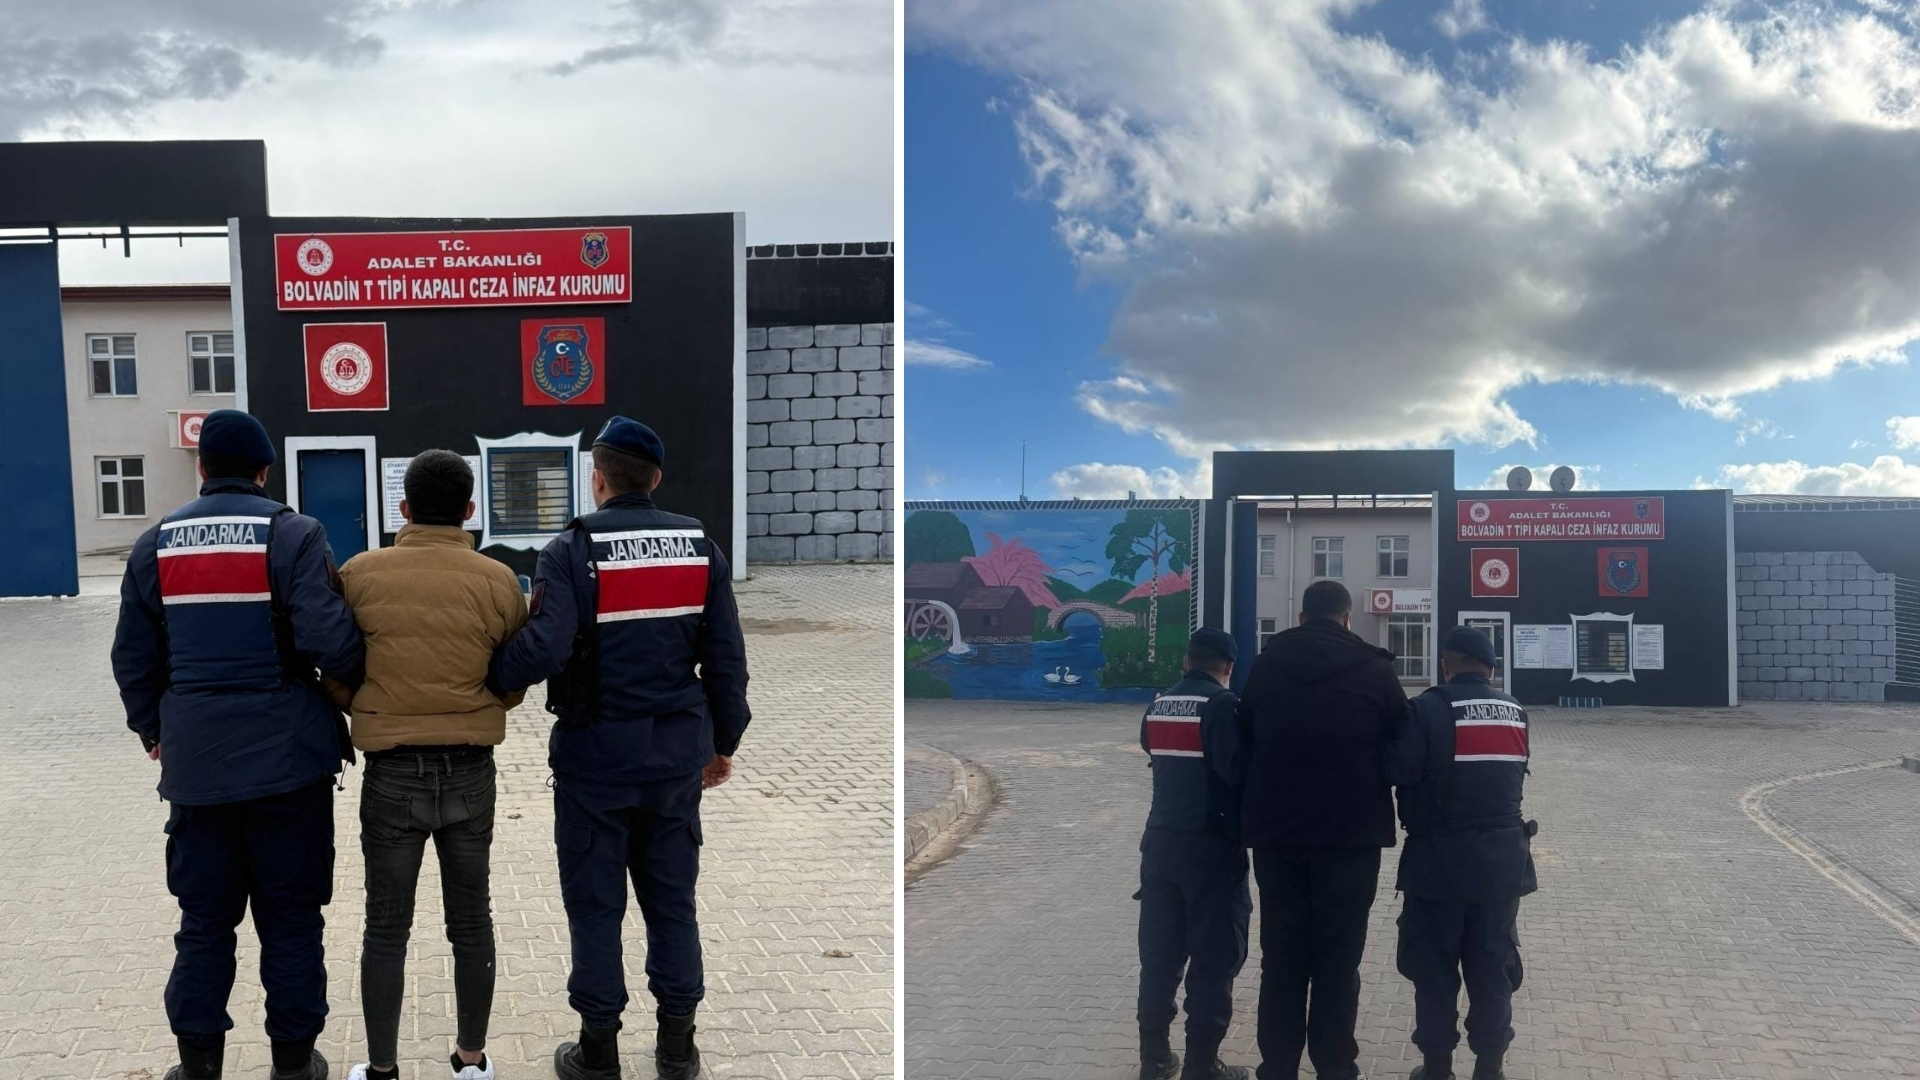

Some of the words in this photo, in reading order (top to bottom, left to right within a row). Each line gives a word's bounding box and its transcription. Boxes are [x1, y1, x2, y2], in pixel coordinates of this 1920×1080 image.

[438, 239, 470, 251] T.C.
[367, 257, 437, 269] ADALET
[443, 252, 542, 268] BAKANLIĞI
[284, 275, 360, 302] BOLVADİN
[363, 280, 373, 300] T
[377, 274, 407, 300] TİPİ
[412, 278, 465, 300] KAPALI
[469, 276, 509, 298] CEZA
[513, 271, 556, 298] İNFAZ
[560, 274, 625, 296] KURUMU
[1552, 510, 1611, 518] BAKANLIĞI
[166, 523, 256, 548] JANDARMA
[1461, 522, 1504, 537] BOLVADİN
[1507, 525, 1513, 536] T
[1514, 522, 1531, 536] TİPİ
[1534, 524, 1565, 536] KAPALI
[1567, 524, 1590, 536] CEZA
[1593, 521, 1619, 535] İNFAZ
[1621, 523, 1660, 535] KURUMU
[607, 537, 697, 561] JANDARMA
[1151, 701, 1198, 716] JANDARMA
[1463, 705, 1520, 721] JANDARMA
